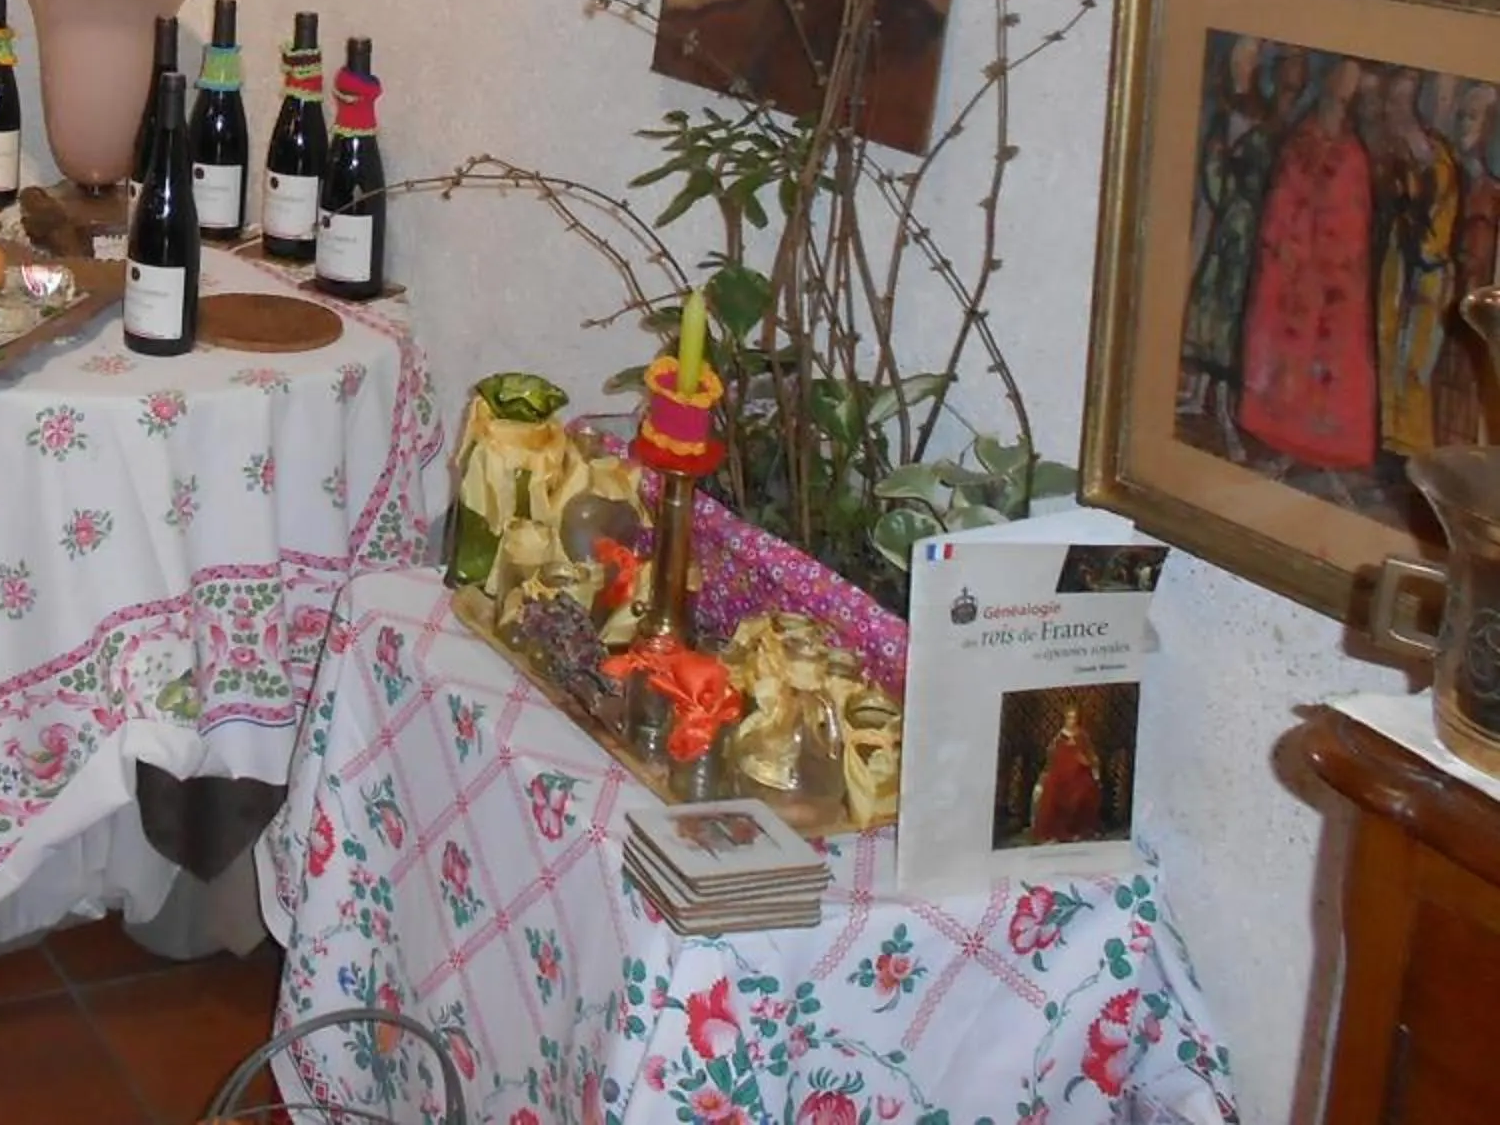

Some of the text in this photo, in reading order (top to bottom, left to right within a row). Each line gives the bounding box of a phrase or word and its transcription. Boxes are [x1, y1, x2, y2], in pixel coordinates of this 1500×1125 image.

[981, 624, 1014, 646] rois
[1018, 628, 1037, 644] de
[1041, 620, 1109, 642] France
